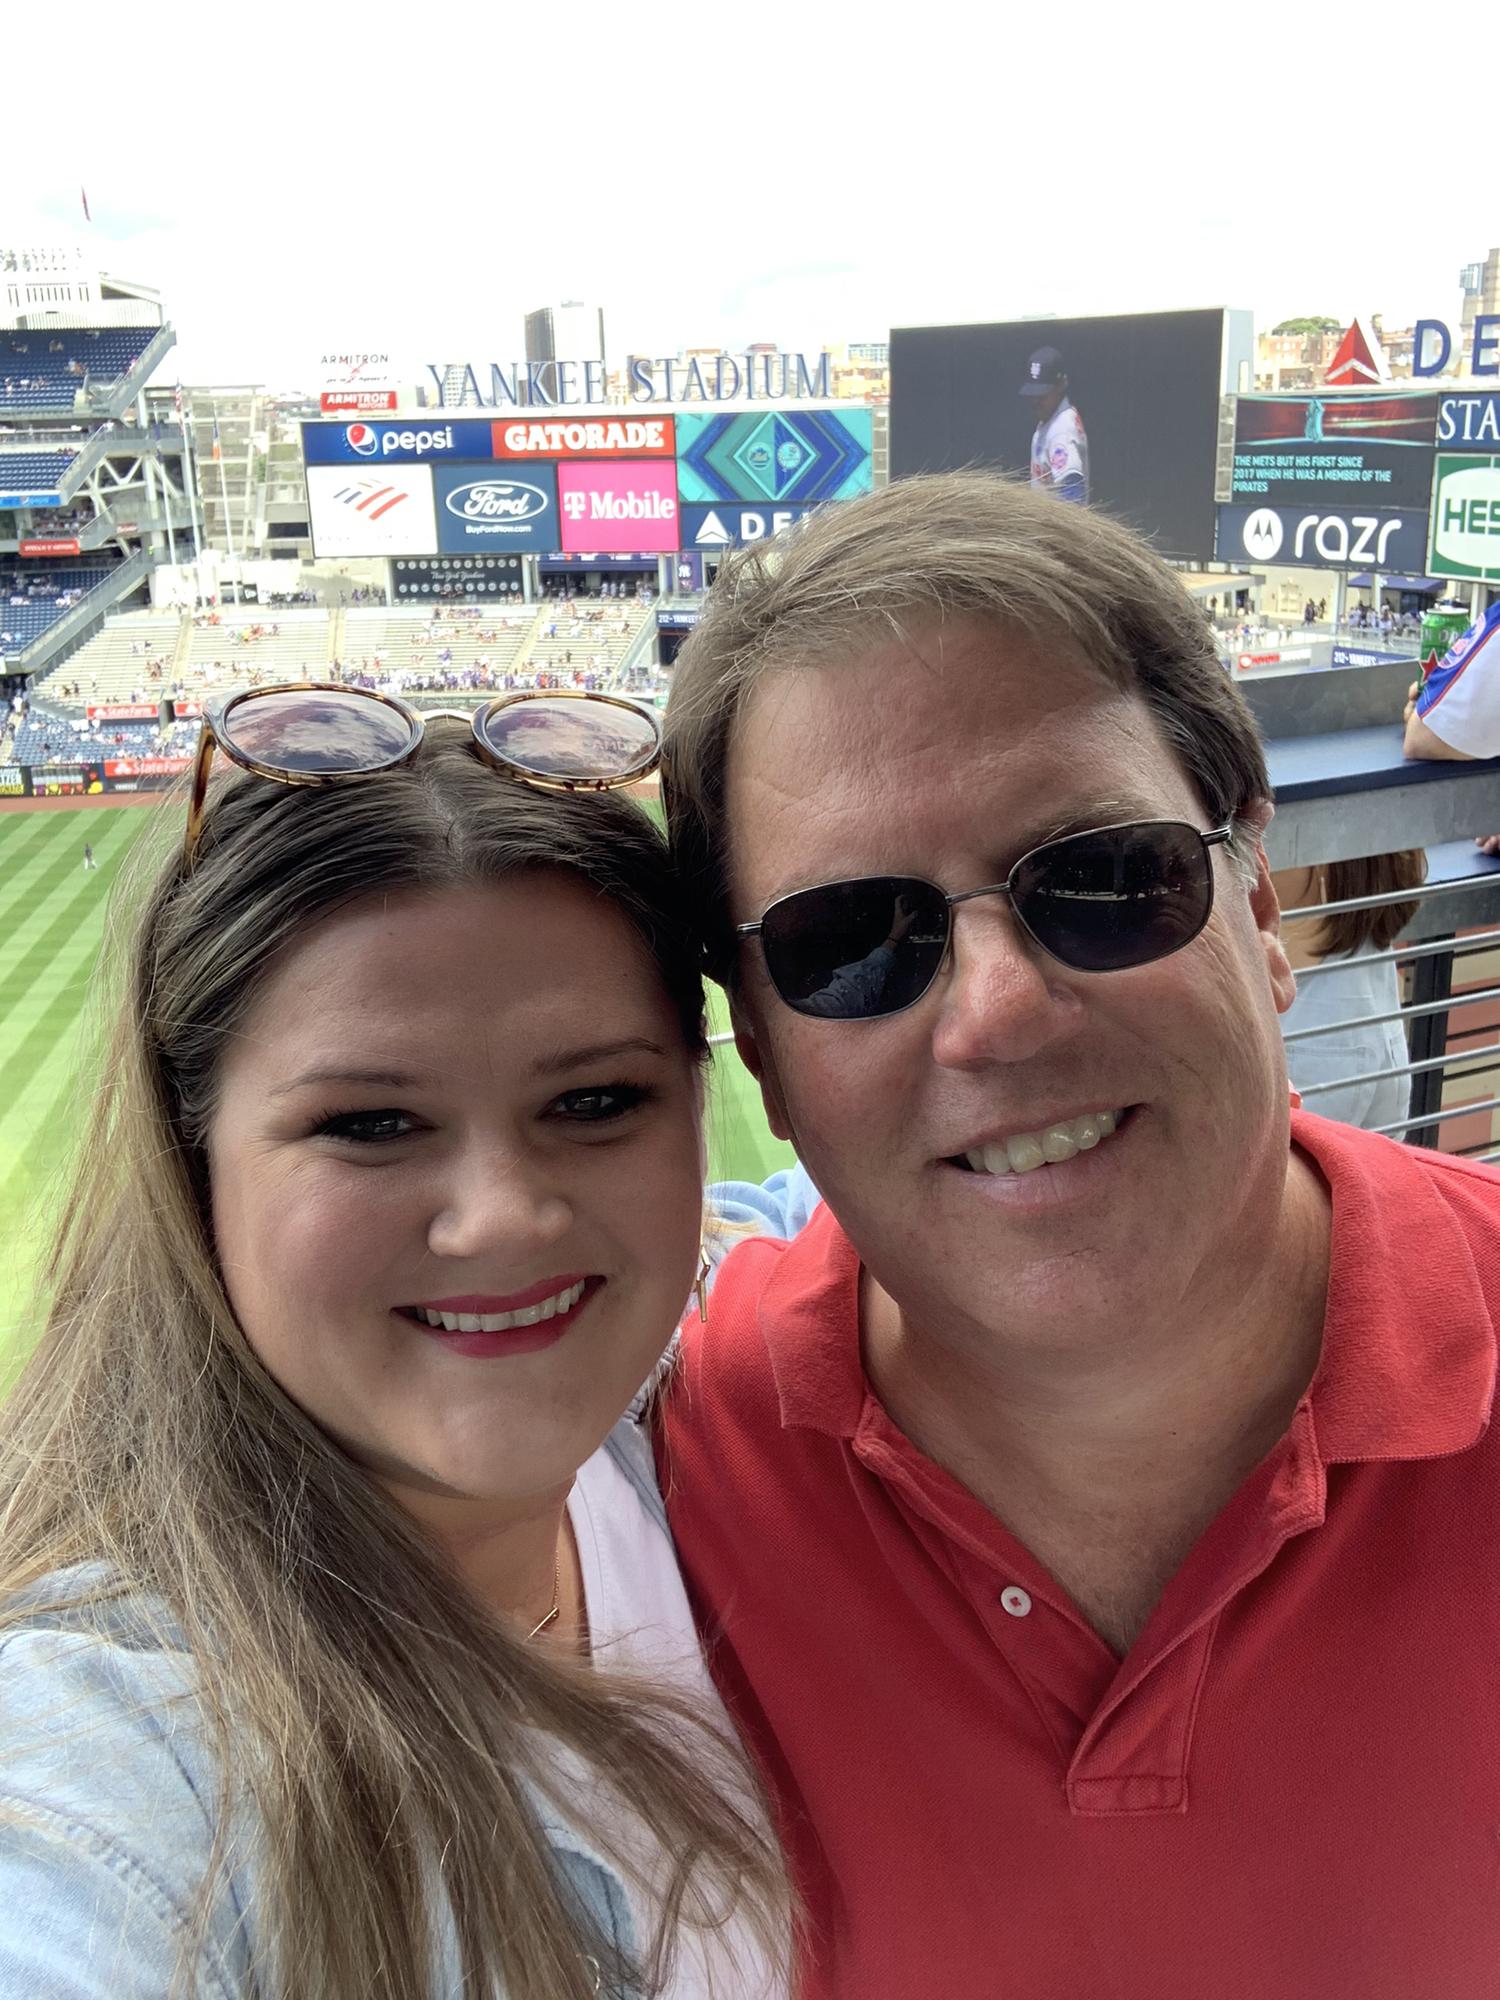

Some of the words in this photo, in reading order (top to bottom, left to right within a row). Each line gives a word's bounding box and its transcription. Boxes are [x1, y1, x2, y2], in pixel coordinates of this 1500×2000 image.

[320, 353, 388, 365] ARMITRON
[426, 360, 607, 409] YANKEE
[632, 352, 832, 402] STADIUM
[327, 391, 389, 404] ARMITRON
[1438, 399, 1500, 440] STA
[382, 425, 454, 455] pepsi
[504, 421, 664, 451] GATORADE
[1233, 468, 1254, 479] 2017
[1255, 469, 1281, 479] WHEN
[1282, 469, 1295, 480] HE
[1295, 469, 1316, 480] WAS
[1316, 469, 1324, 480] A
[1324, 469, 1361, 481] MEMBER
[1361, 470, 1374, 481] OF
[1374, 470, 1392, 482] THE
[1234, 455, 1252, 467] THE
[1252, 455, 1275, 467] METS
[1276, 455, 1294, 467] BUT
[1295, 456, 1311, 467] HIS
[1311, 456, 1336, 467] FIRST
[1337, 456, 1363, 468] SINCE
[464, 486, 530, 515] Ford
[1232, 481, 1268, 493] PIRATES
[465, 525, 532, 535] BuyFordNow.com
[740, 511, 810, 540] DE
[1295, 515, 1402, 565] razr
